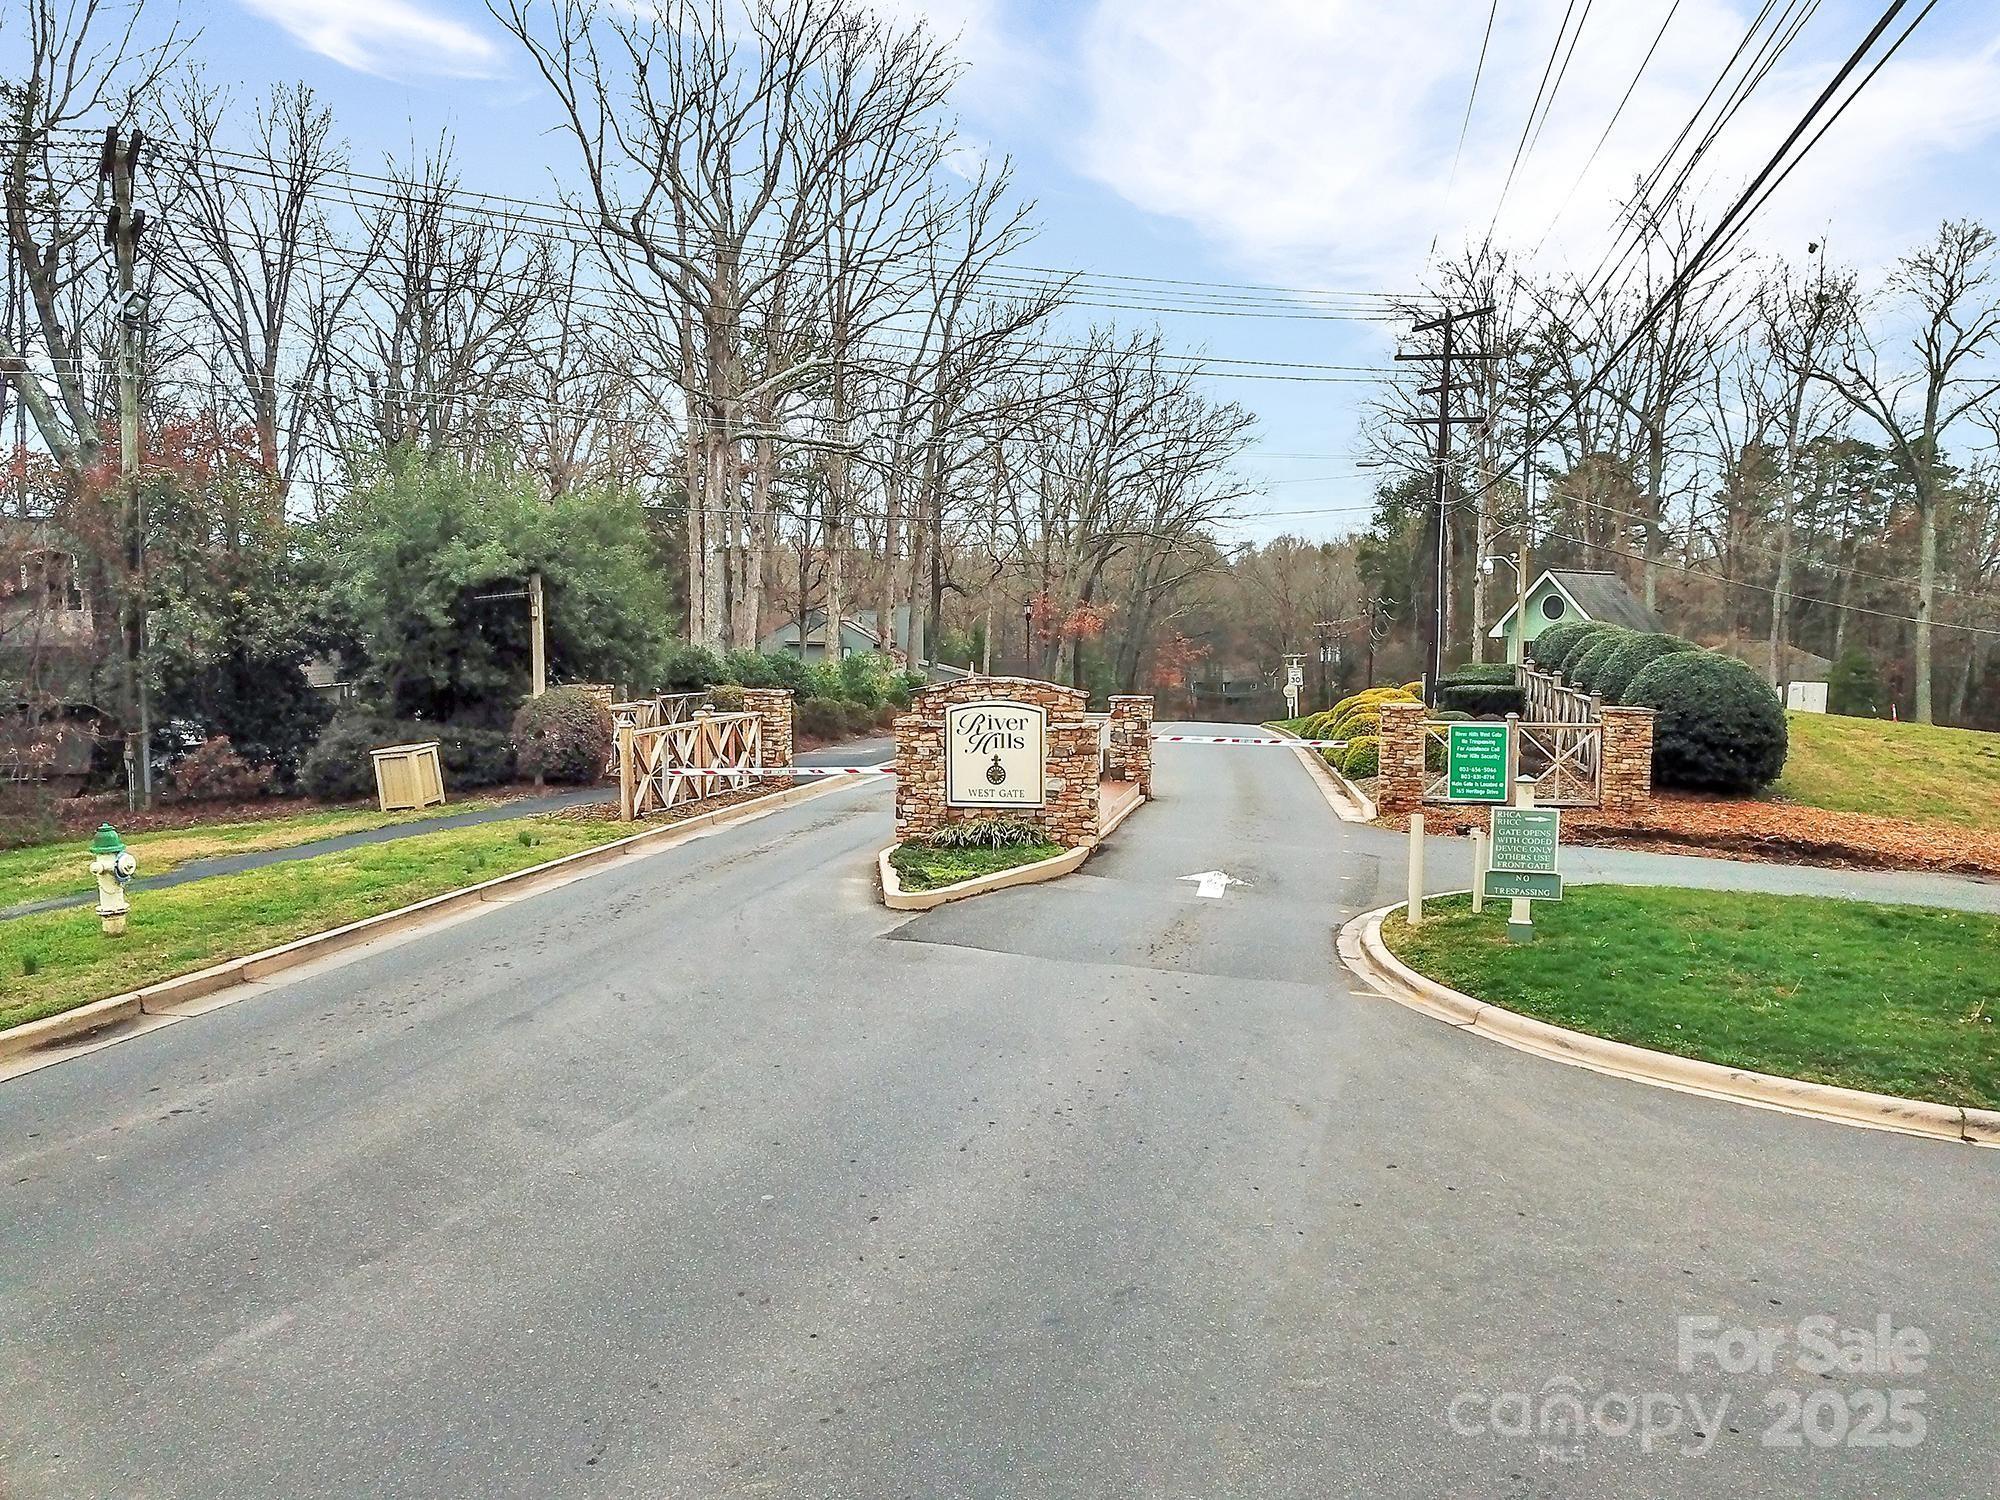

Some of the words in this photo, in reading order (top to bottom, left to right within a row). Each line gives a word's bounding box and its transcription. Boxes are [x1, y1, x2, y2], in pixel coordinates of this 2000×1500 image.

[957, 712, 1028, 735] River
[965, 732, 1024, 754] Hills
[968, 788, 995, 797] WEST
[999, 788, 1025, 797] GATE
[1465, 788, 1485, 796] Heritage
[1497, 818, 1521, 826] RHCC
[1498, 828, 1521, 836] GATE
[1523, 829, 1551, 837] OPENS
[1497, 836, 1520, 844] WITH
[1521, 837, 1553, 845] CODED
[1529, 845, 1553, 853] ONLY
[1497, 853, 1531, 861] OTHERS
[1533, 854, 1551, 862] USE
[1497, 861, 1527, 869] FRONT
[1527, 862, 1551, 870] GATE
[1515, 874, 1530, 882] NO
[1494, 886, 1551, 897] TRESPASSING
